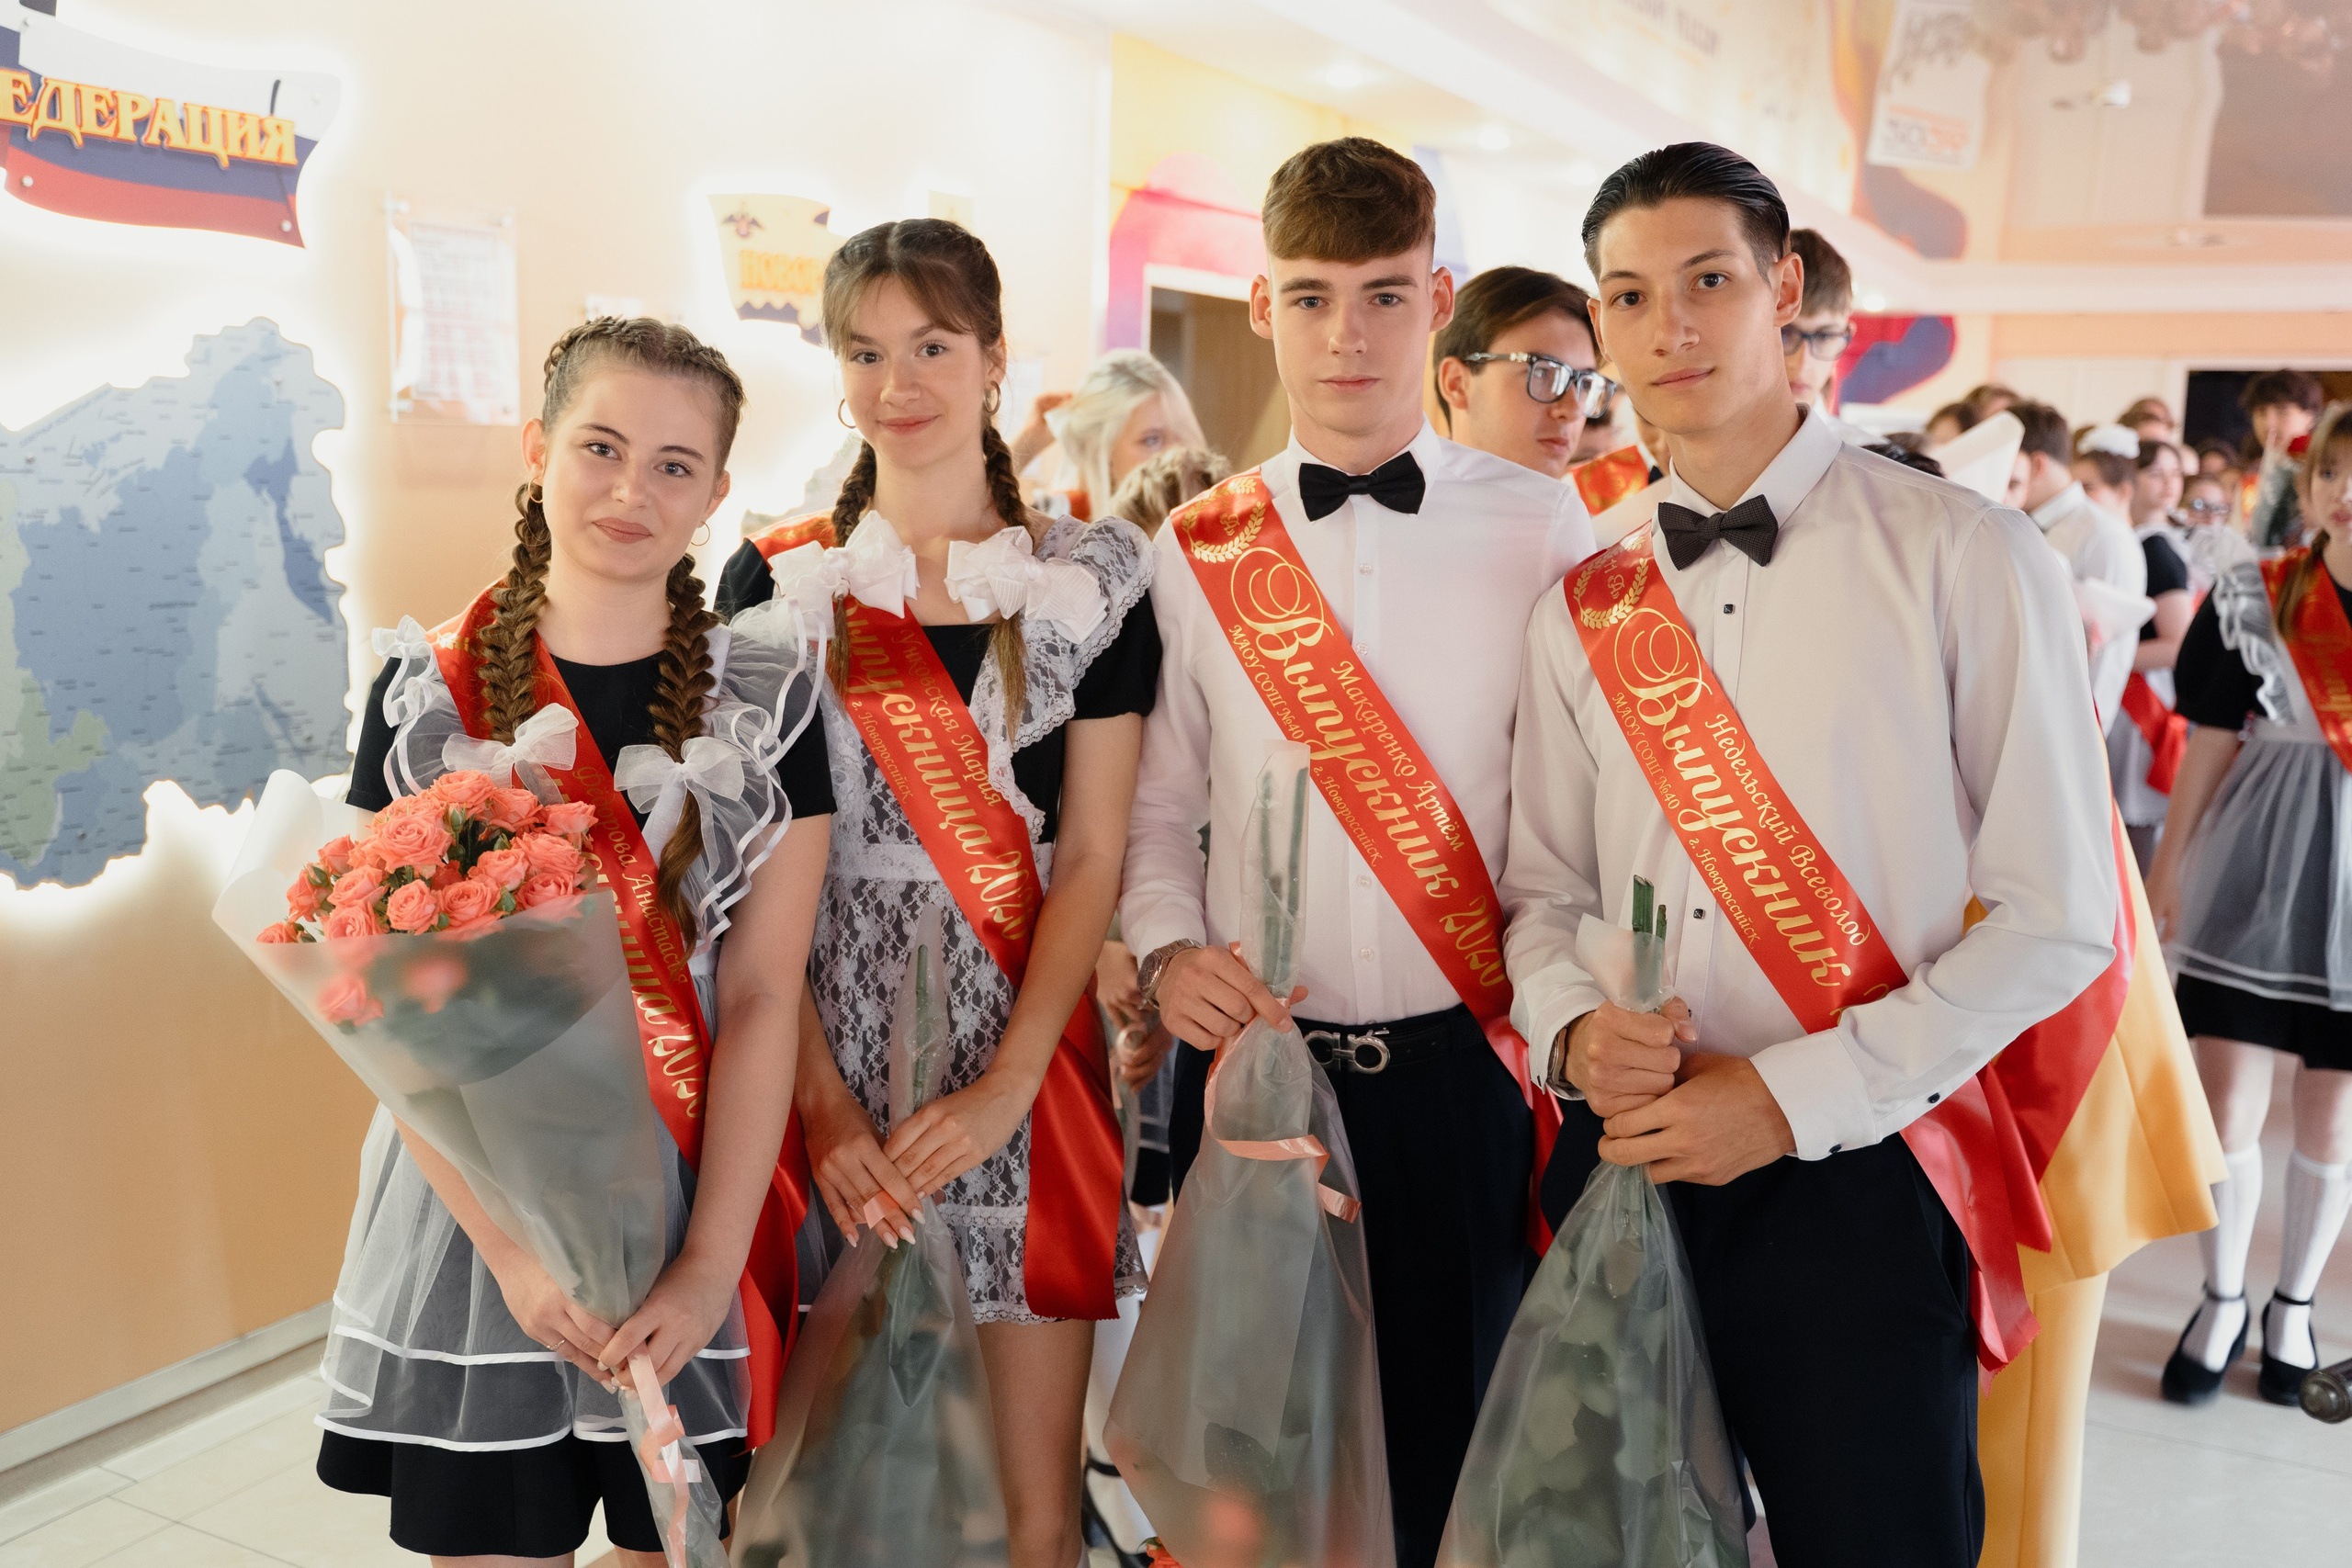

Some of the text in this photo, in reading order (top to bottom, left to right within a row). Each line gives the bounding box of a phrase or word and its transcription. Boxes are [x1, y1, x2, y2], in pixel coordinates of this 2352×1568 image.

[845, 597, 992, 855] ыпускница
[1228, 625, 1305, 740] МАОУ СОШ №40
[1230, 547, 1459, 898] Выпускник
[858, 711, 914, 804] Новороссийск
[951, 734, 1002, 807] Мария
[1330, 660, 1465, 852] Макаренко Артём
[1611, 693, 1680, 810] МАОУ СОШ №40
[1614, 607, 1851, 987] Выпускник
[1320, 775, 1384, 867] Новороссийск
[1705, 713, 1800, 845] Недельский
[1788, 844, 1871, 946] Всеволод
[1696, 848, 1761, 950] Новороссийск
